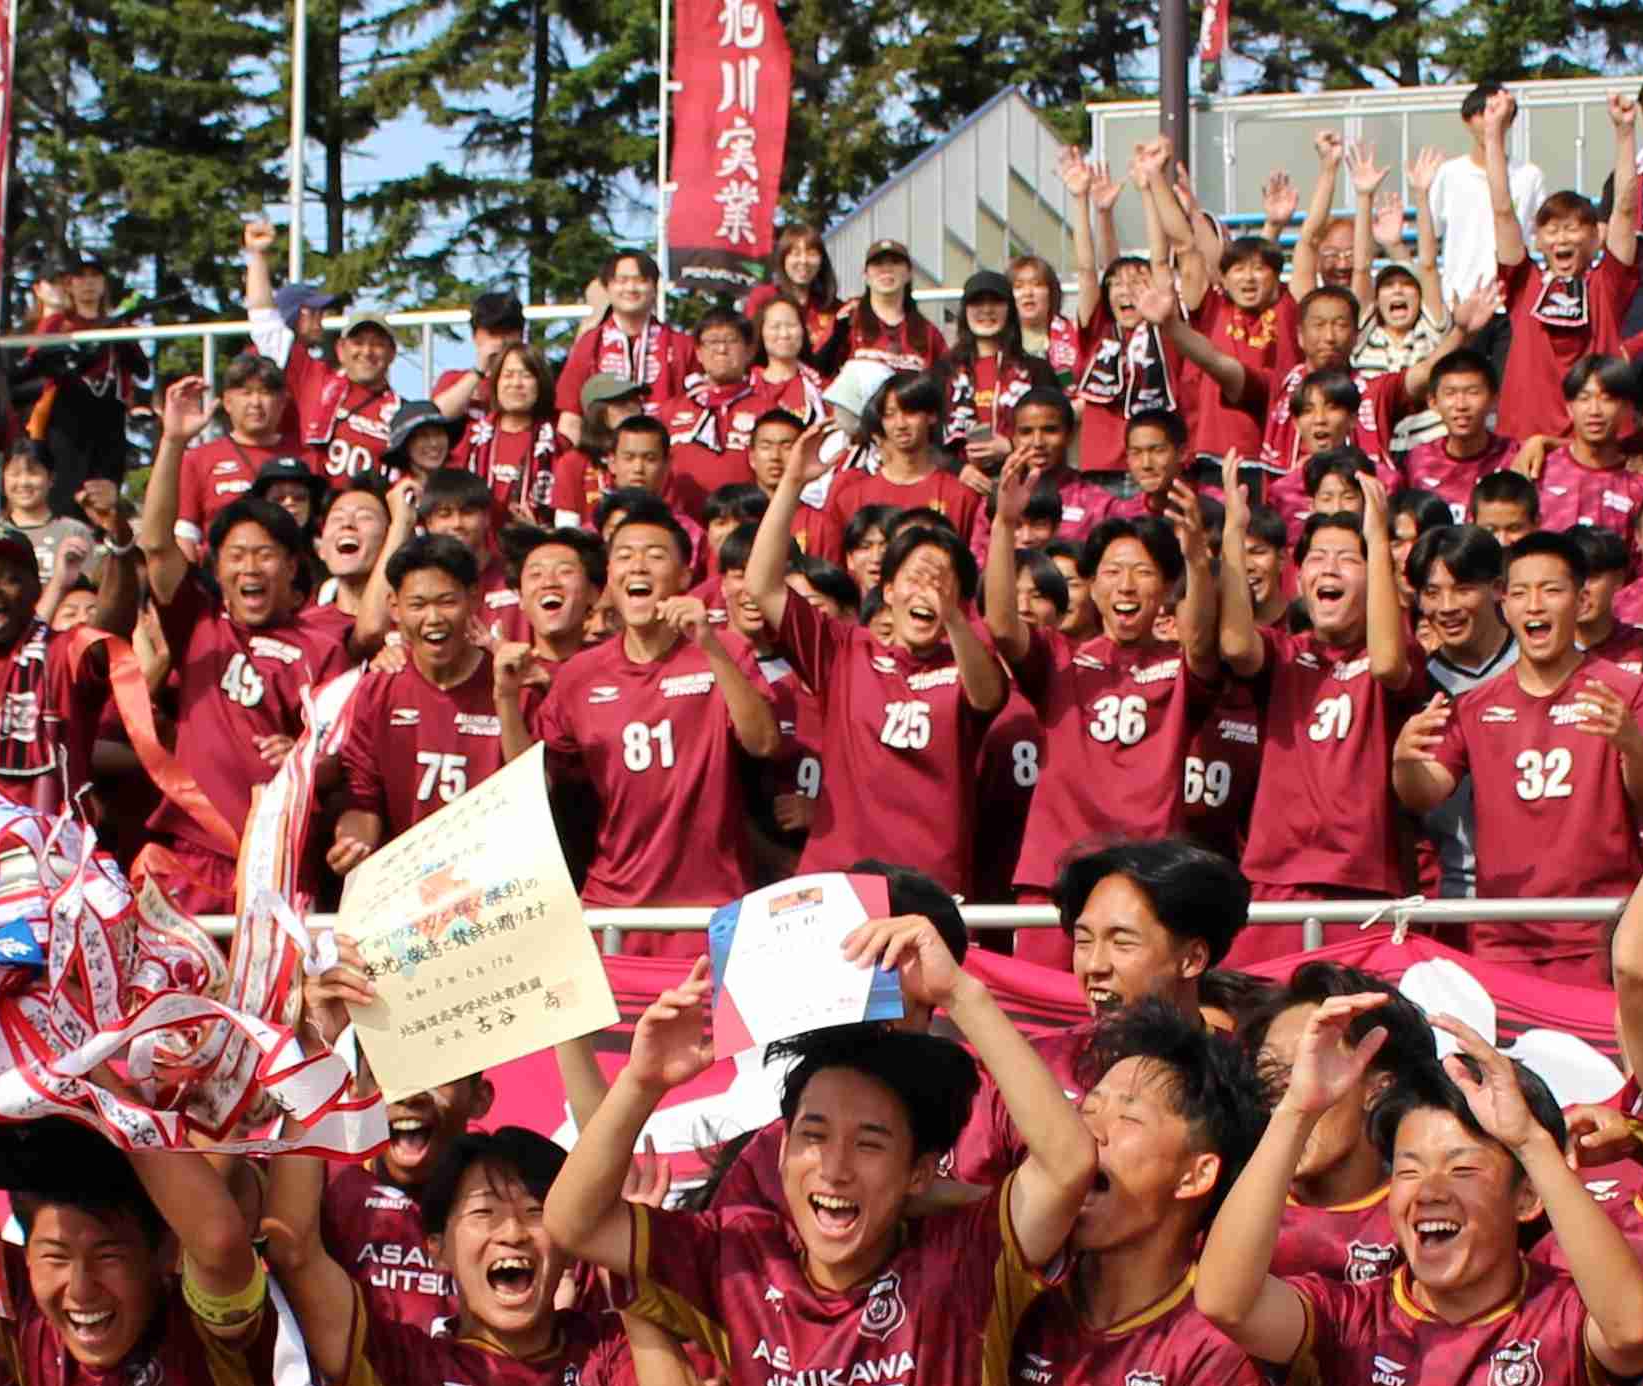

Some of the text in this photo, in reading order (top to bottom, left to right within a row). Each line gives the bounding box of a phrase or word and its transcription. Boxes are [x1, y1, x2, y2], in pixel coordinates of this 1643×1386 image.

[713, 0, 766, 245] 旭川実業
[1089, 695, 1147, 746] 36
[1309, 693, 1352, 742] 31
[621, 718, 675, 773] 81
[415, 752, 468, 801] 75
[1183, 756, 1231, 807] 69
[1515, 748, 1573, 802] 32
